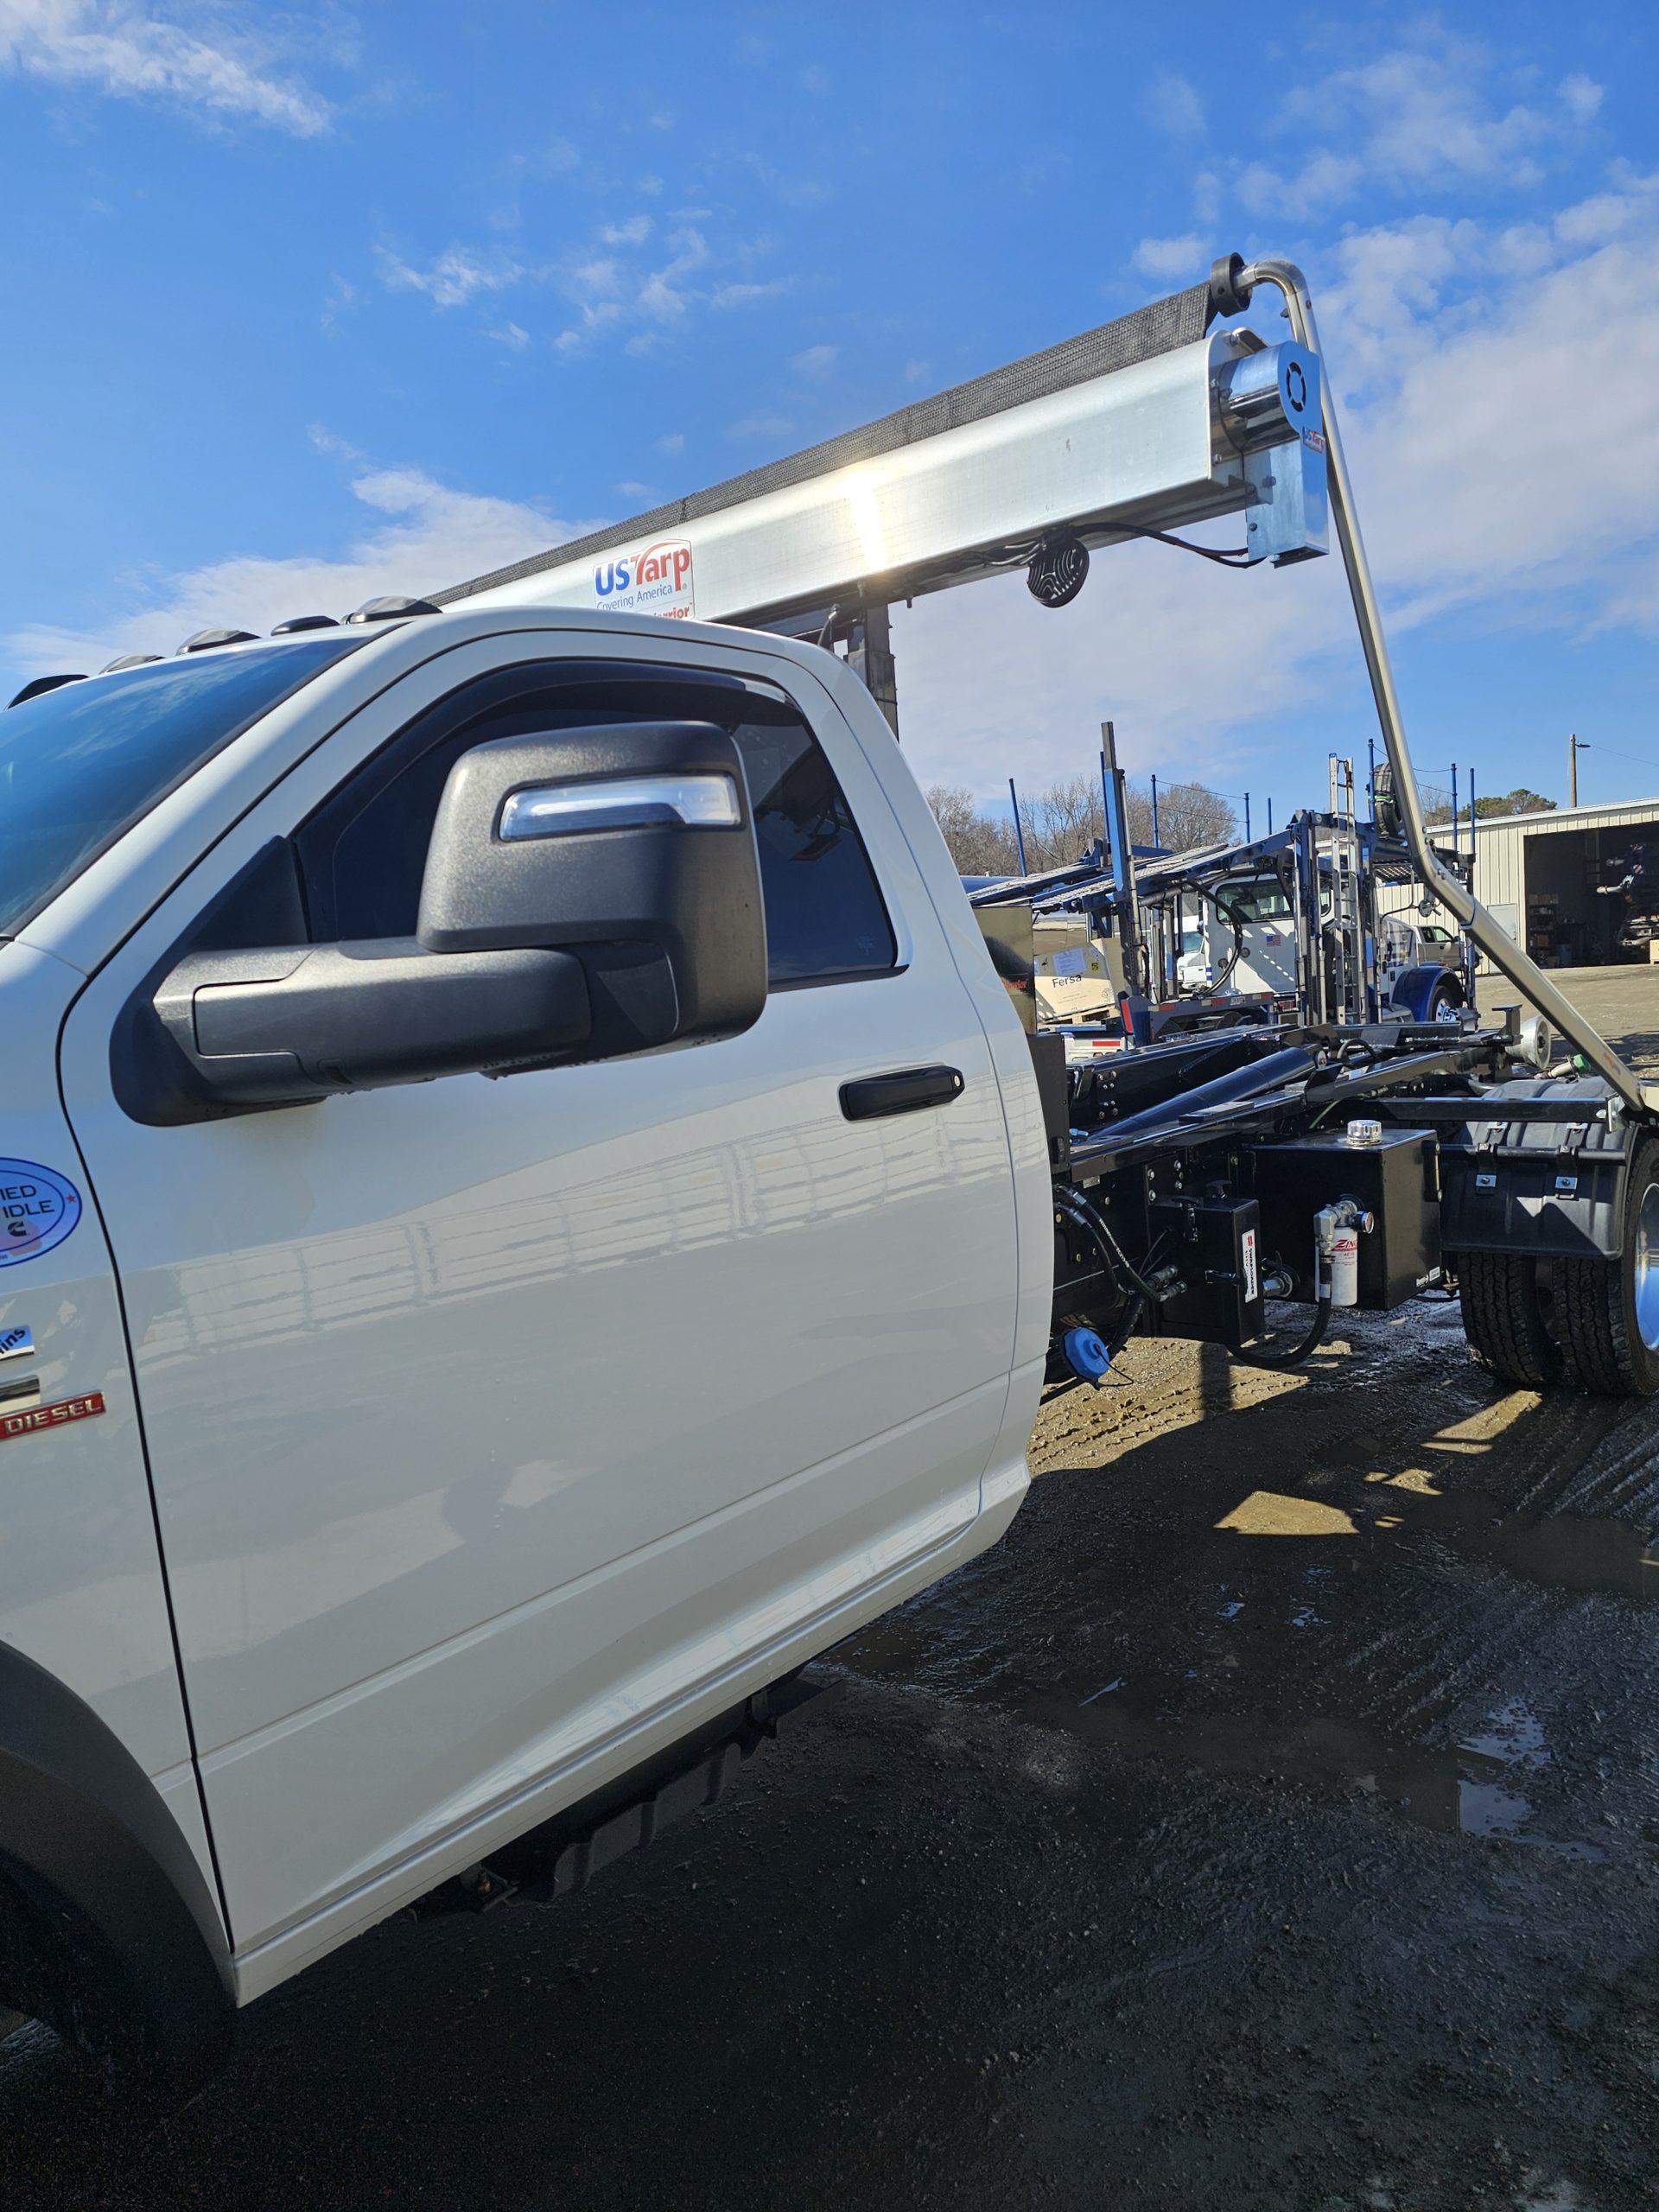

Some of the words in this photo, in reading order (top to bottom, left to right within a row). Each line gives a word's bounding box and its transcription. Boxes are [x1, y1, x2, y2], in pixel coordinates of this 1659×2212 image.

[597, 595, 634, 611] Covering
[637, 584, 672, 603] America
[1052, 975, 1082, 988] Fersa
[3, 1199, 55, 1219] IDLE
[4, 1399, 102, 1434] DIESEL
